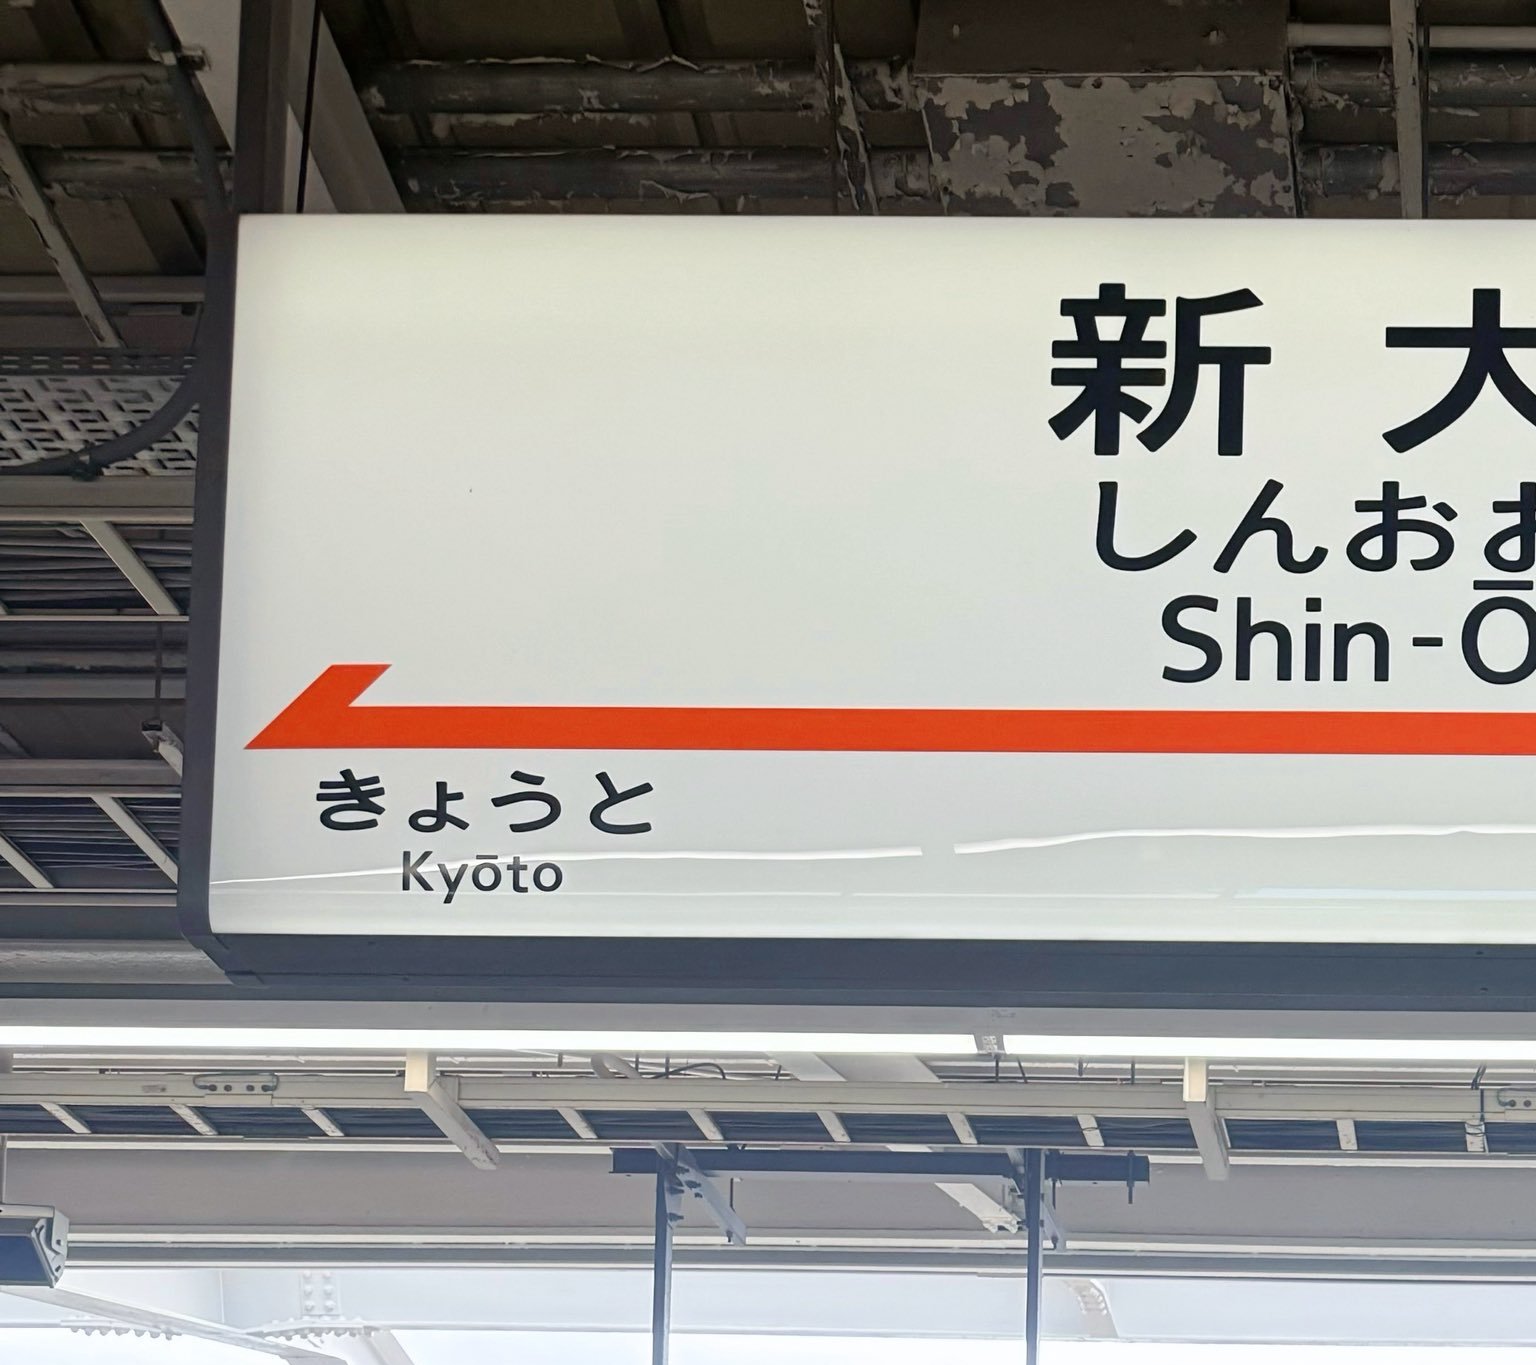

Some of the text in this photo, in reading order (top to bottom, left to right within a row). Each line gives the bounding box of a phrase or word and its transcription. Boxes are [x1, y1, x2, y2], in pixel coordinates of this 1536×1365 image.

[315, 768, 654, 835] きょうと
[402, 850, 563, 904] Kyōto
